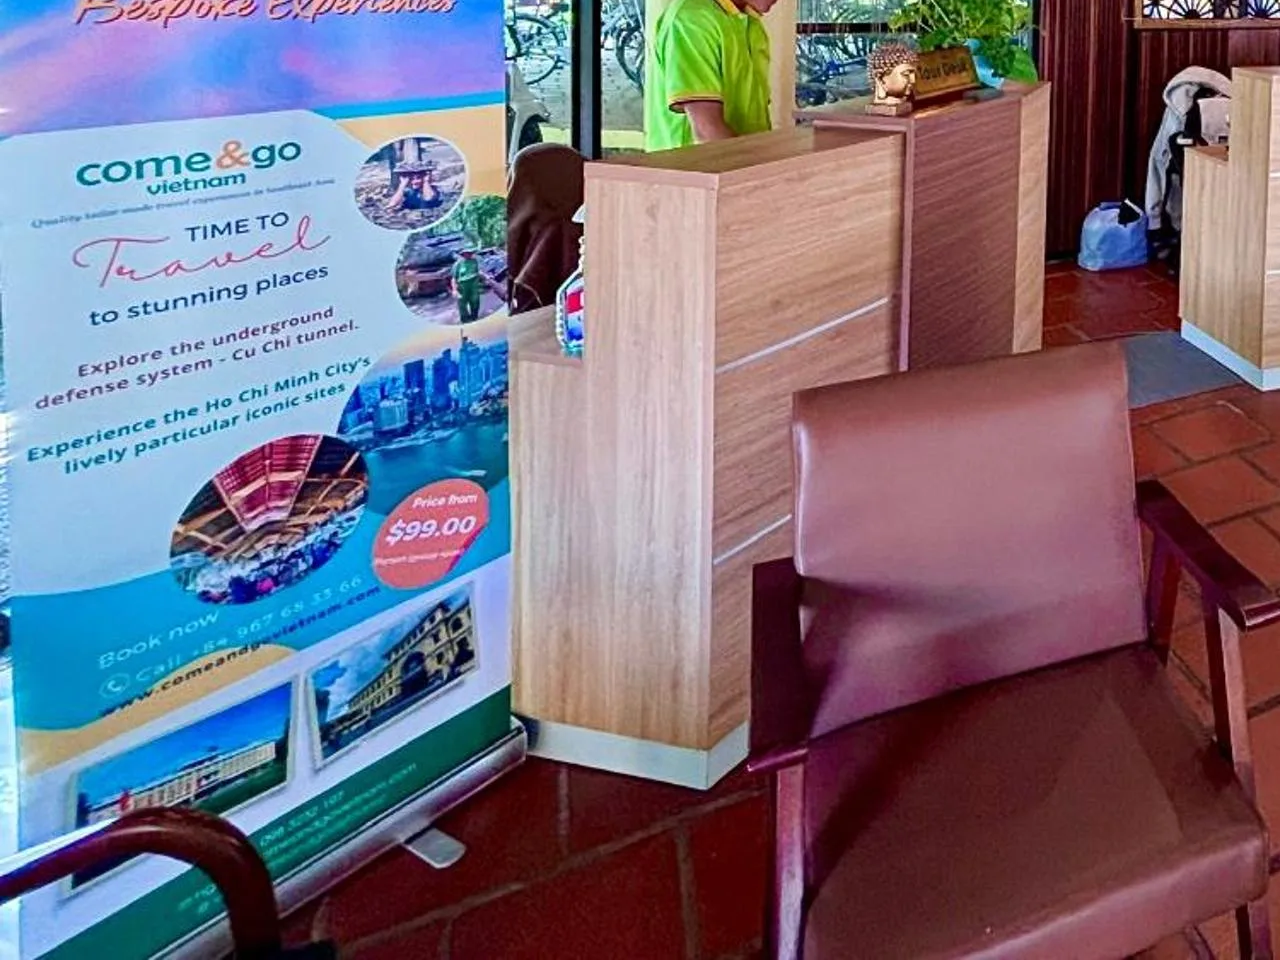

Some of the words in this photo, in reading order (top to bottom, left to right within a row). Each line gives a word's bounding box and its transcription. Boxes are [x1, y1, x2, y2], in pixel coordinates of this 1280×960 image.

[76, 140, 301, 186] come&go
[146, 172, 246, 195] vietnam
[72, 215, 331, 288] Travel
[185, 218, 250, 242] TIME
[256, 212, 290, 231] TO
[90, 309, 119, 327] to
[128, 281, 248, 319] stunning
[256, 266, 329, 296] places
[35, 377, 129, 410] defense
[136, 357, 213, 388] system
[233, 346, 257, 362] Cu
[263, 335, 292, 354] Chi
[297, 319, 360, 346] tunnel.
[78, 348, 163, 378] Explore
[170, 337, 205, 357] the
[212, 306, 334, 348] underground
[27, 418, 156, 464] Experience
[163, 404, 199, 424] the
[205, 395, 233, 414] Ho
[239, 384, 270, 404] Chi
[274, 370, 320, 394] Minh
[325, 355, 372, 382] City's
[65, 445, 128, 475] lively
[134, 415, 239, 456] particular
[246, 399, 301, 423] iconic
[305, 381, 347, 404] sites
[385, 515, 477, 547] $99.00
[412, 496, 446, 509] Price
[98, 634, 162, 670] Book
[169, 611, 219, 641] now
[136, 653, 182, 682] Call
[237, 612, 275, 640] 967
